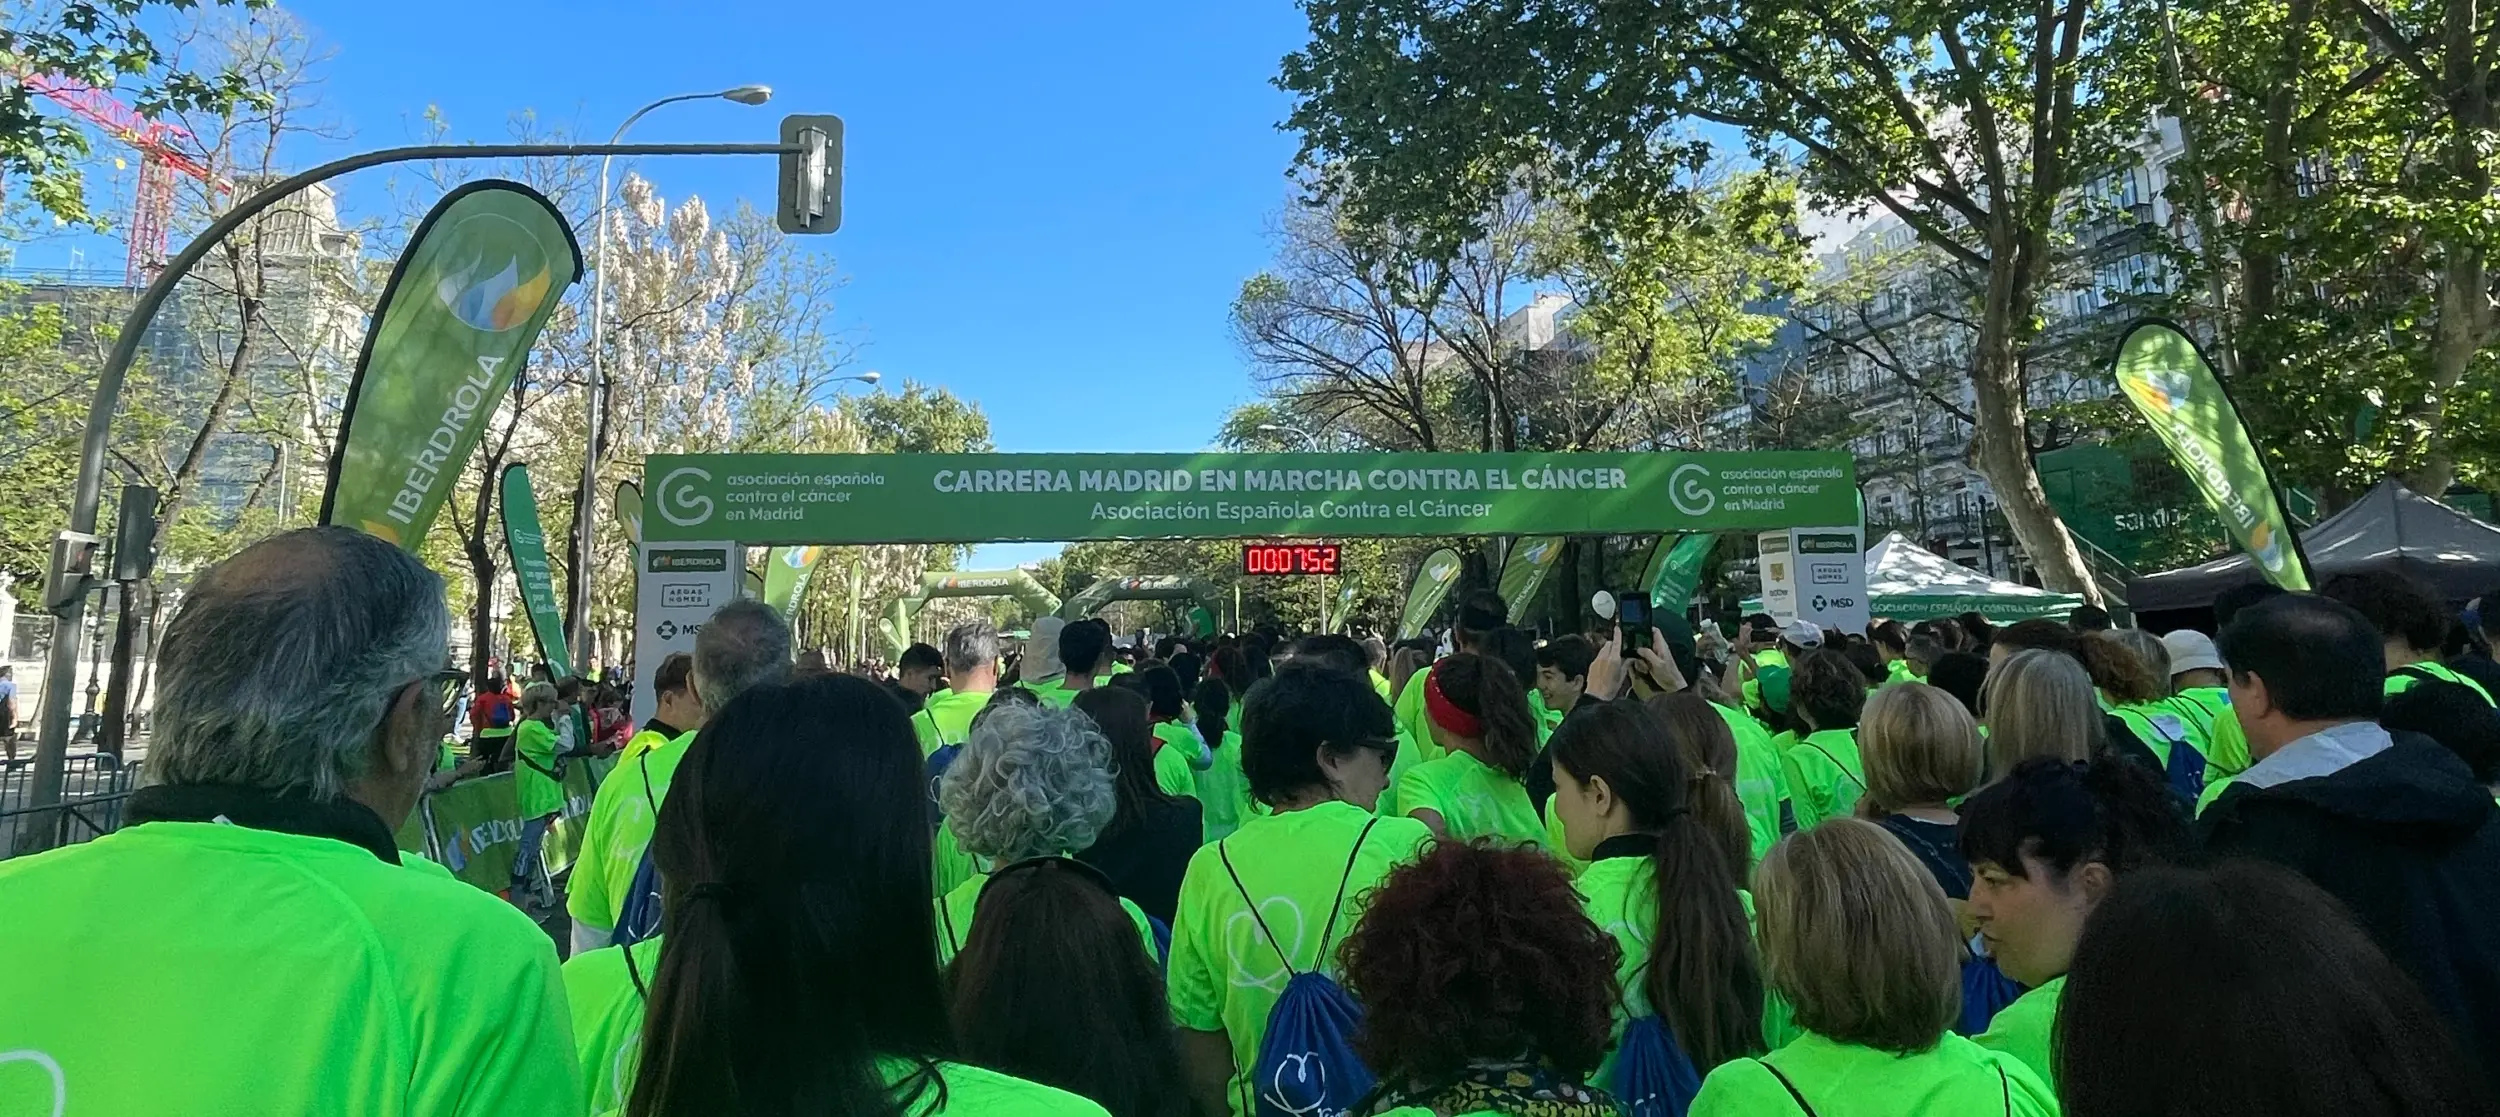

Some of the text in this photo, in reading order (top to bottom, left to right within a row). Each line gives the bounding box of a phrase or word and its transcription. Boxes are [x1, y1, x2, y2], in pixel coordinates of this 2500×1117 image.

[386, 355, 506, 525] IBERDROLA
[726, 471, 885, 488] asociación española
[933, 463, 1628, 493] CARRERA MADRID EN MARCHA CONTRA EL CÁNCER
[1720, 466, 1844, 482] asociación española
[725, 489, 852, 504] contra el cáncer
[1722, 483, 1820, 495] contra el cáncer
[1089, 498, 1493, 523] Asociación Española Contra el Cáncer
[1724, 498, 1785, 511] en Madrid
[725, 506, 804, 521] en Madrid
[957, 578, 1010, 589] IBERDROLA
[1830, 598, 1854, 608] MSD
[682, 624, 702, 636] MS
